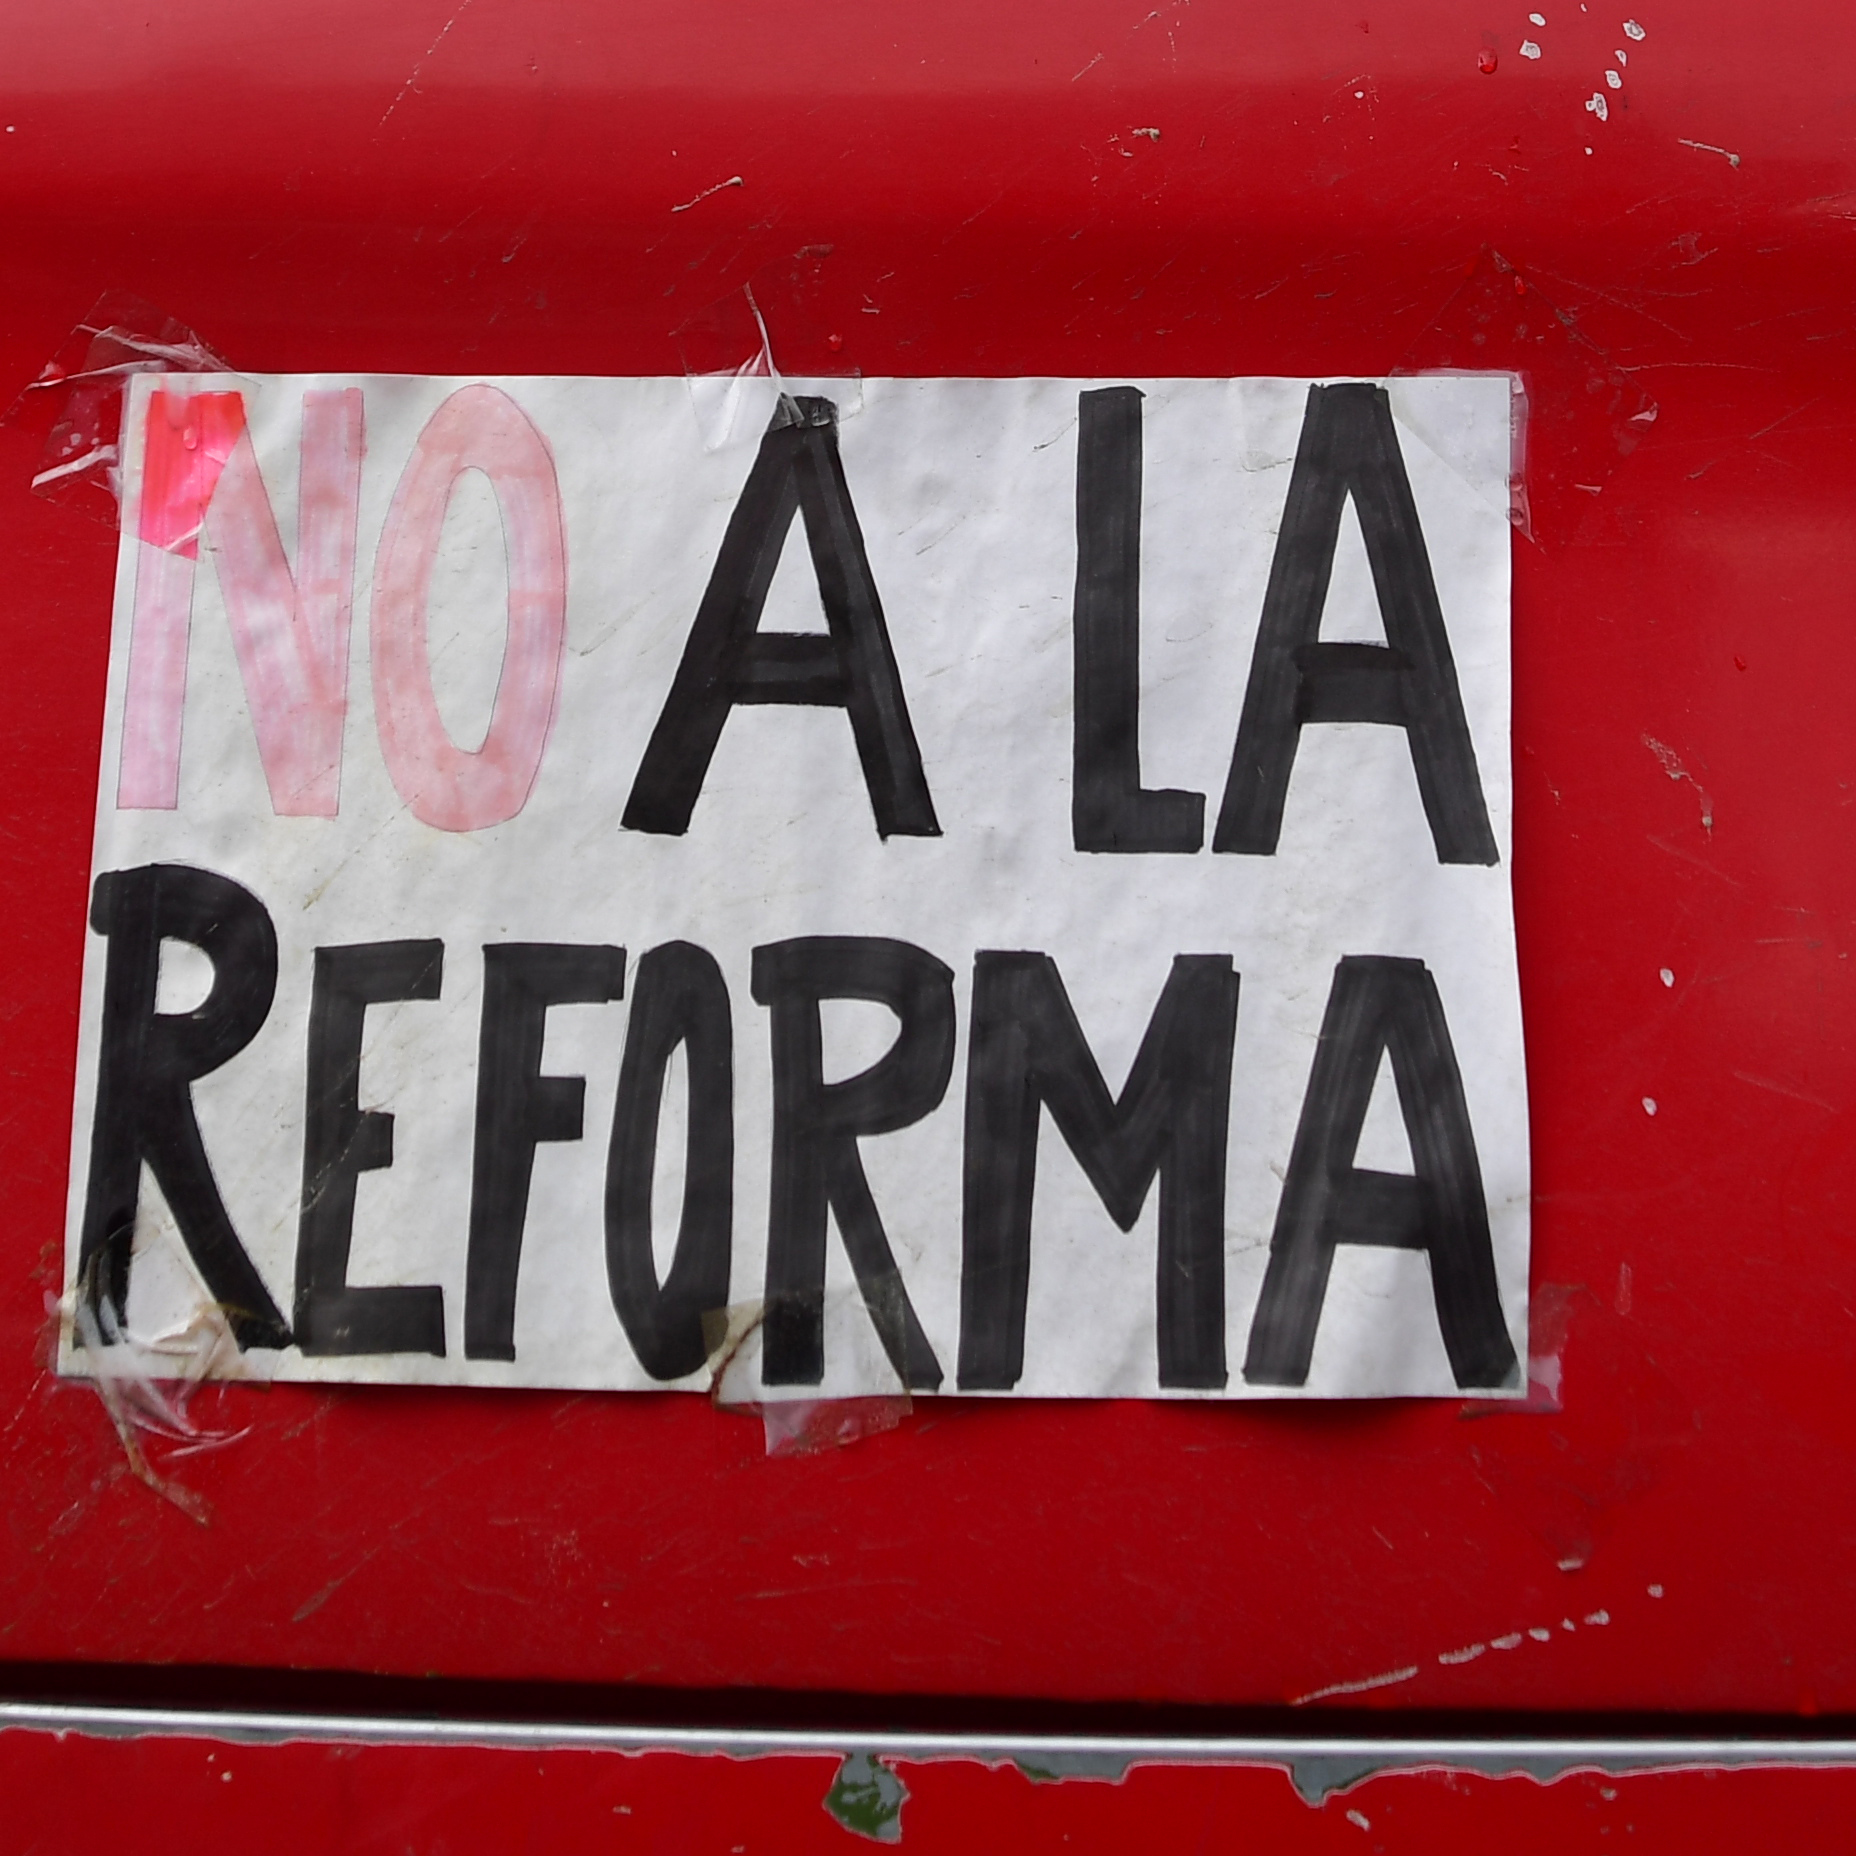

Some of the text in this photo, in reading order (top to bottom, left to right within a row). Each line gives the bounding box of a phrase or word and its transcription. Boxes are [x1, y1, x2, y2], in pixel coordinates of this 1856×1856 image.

[116, 382, 1500, 866] NO A LA
[70, 861, 1528, 1392] REFORMA
